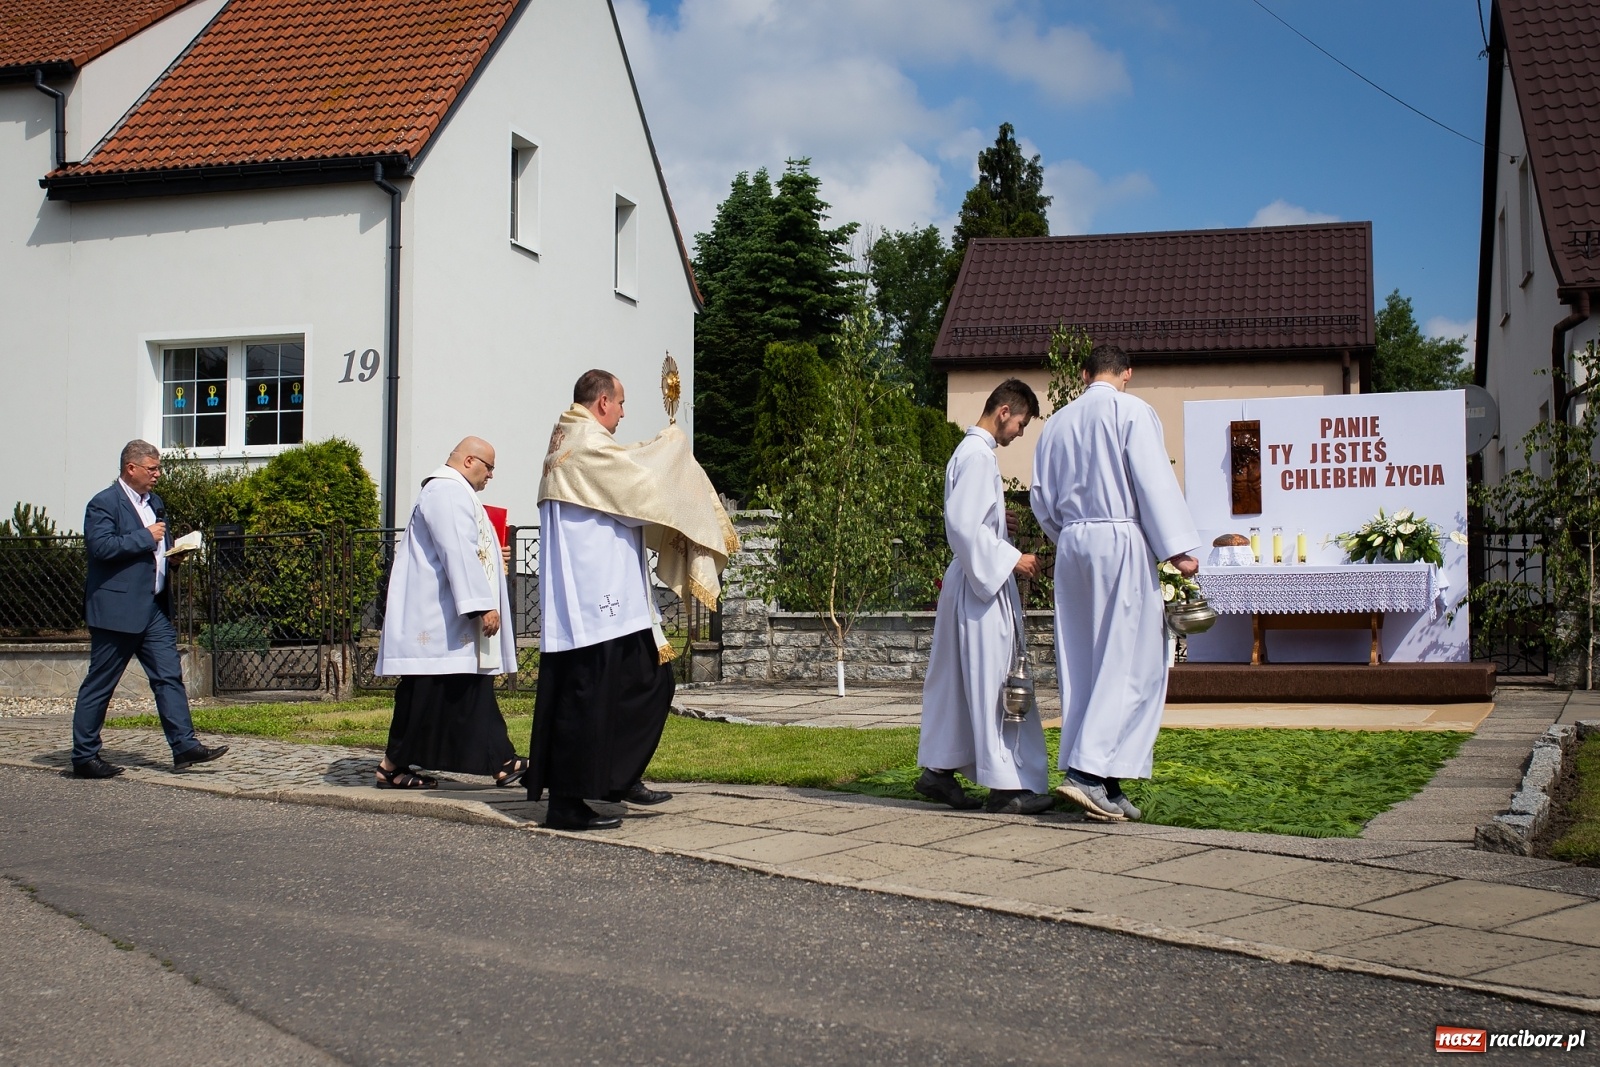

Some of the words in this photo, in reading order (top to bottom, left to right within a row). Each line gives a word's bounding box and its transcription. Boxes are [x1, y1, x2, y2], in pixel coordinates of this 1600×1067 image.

[338, 348, 380, 383] 19
[1320, 416, 1380, 438] PANIE
[1268, 444, 1293, 465] TY
[1310, 437, 1387, 464] JESTEŚ
[1281, 467, 1376, 490] CHLEBEM
[1385, 462, 1445, 487] ŻYCIA
